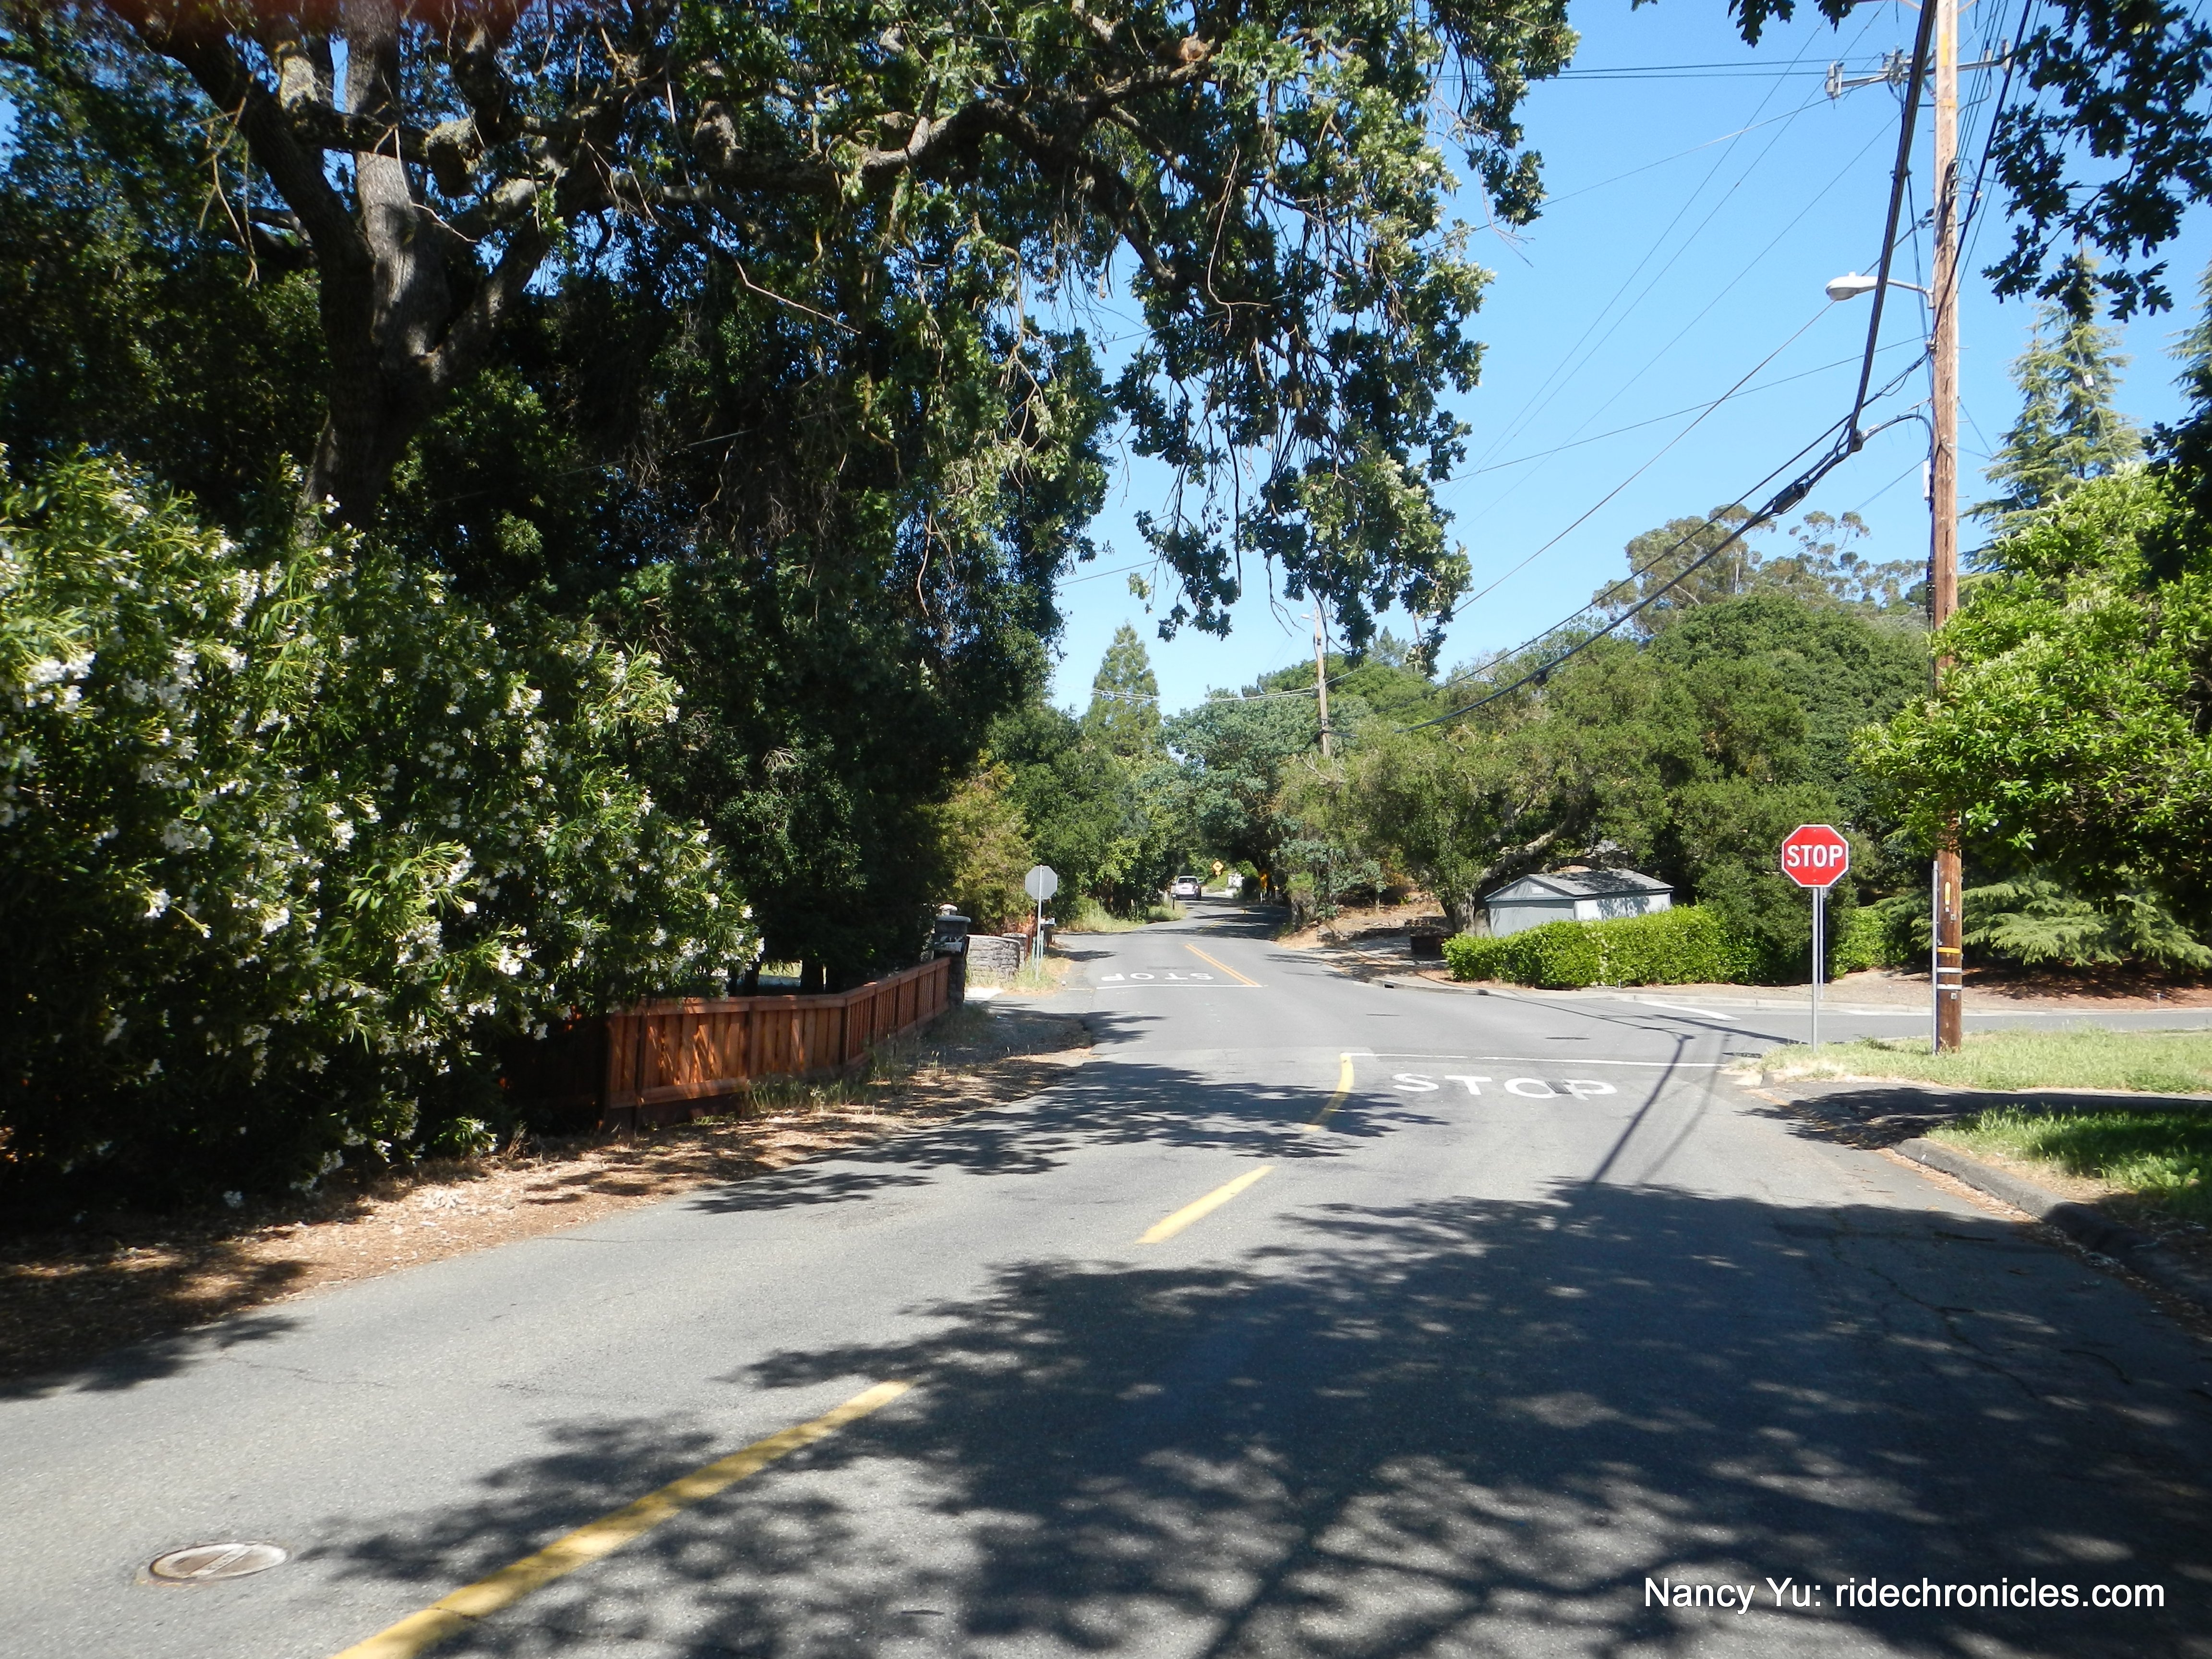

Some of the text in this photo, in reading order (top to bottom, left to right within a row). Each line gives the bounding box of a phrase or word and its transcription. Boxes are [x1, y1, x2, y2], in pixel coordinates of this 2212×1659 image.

[1787, 844, 1843, 867] STOP
[1101, 973, 1214, 981] STOP
[1393, 1072, 1618, 1100] STOP
